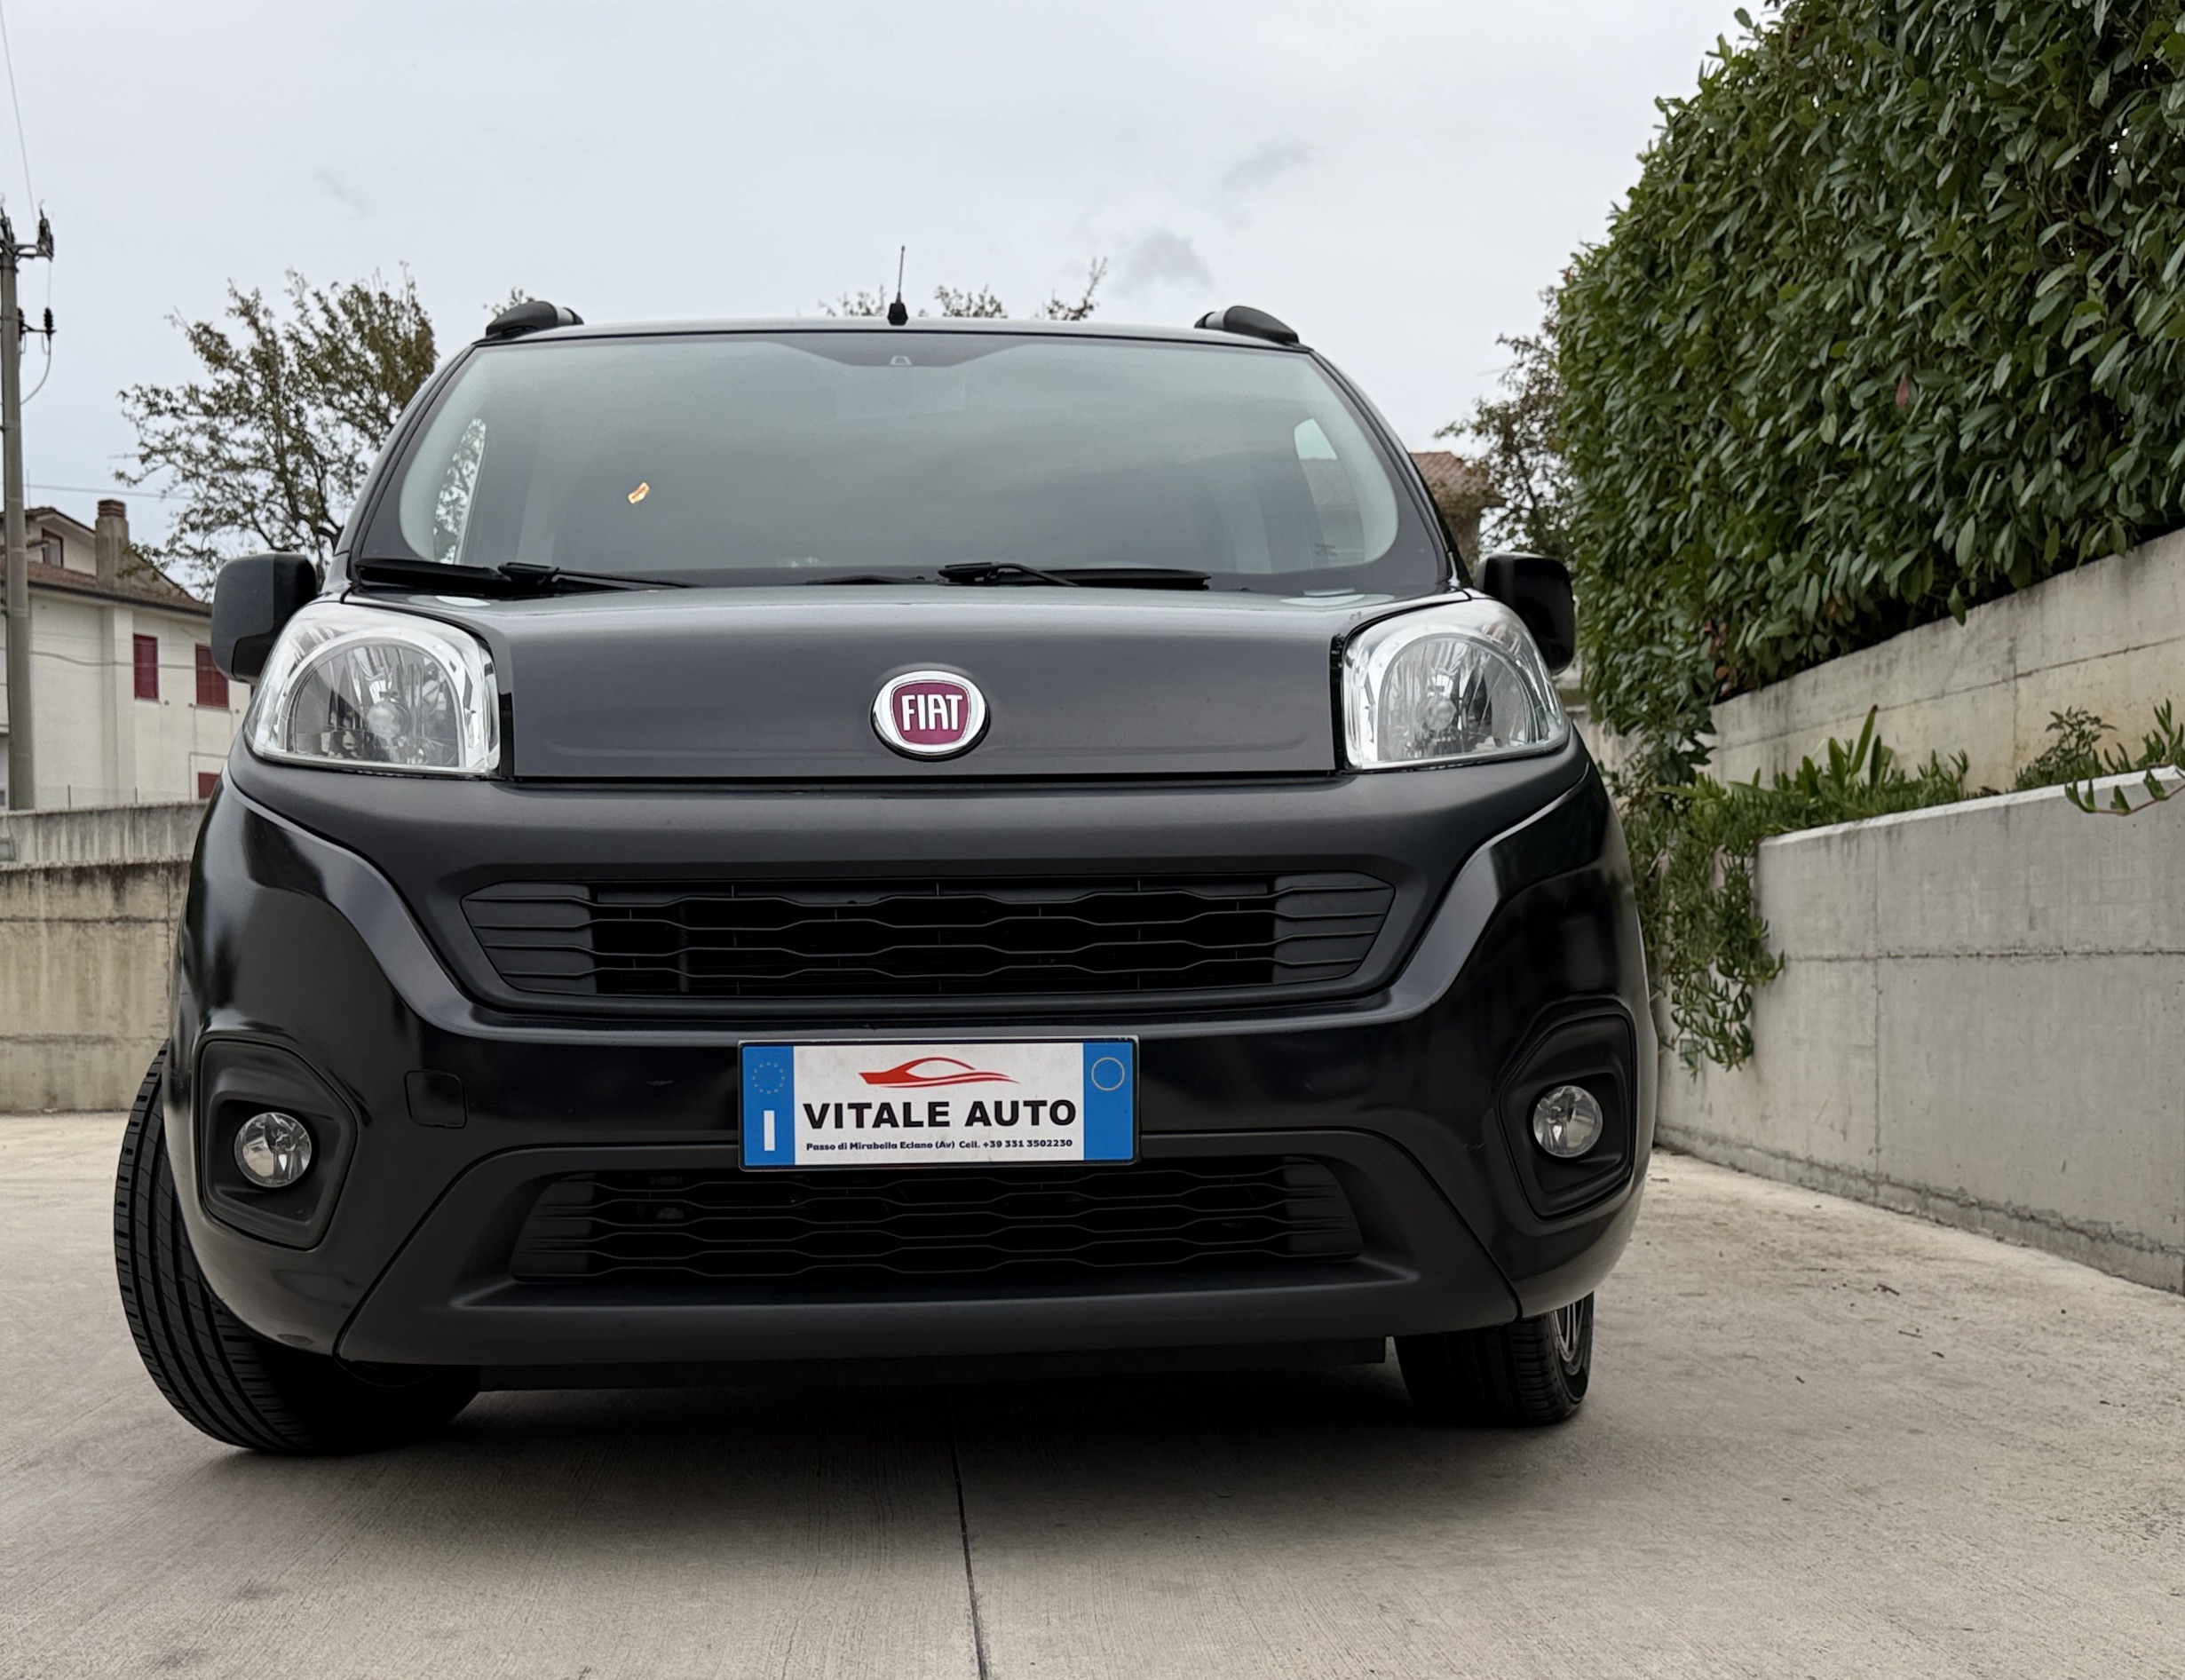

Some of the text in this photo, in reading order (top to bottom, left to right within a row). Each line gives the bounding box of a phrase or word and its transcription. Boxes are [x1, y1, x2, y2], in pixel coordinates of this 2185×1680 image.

[901, 693, 963, 732] FIAT
[764, 1109, 776, 1152] I
[803, 1099, 1077, 1129] VITALE AUTO
[805, 1138, 1073, 1152] Passo di Mirabella Eclano (Av) Cell. +39 331 3502230
